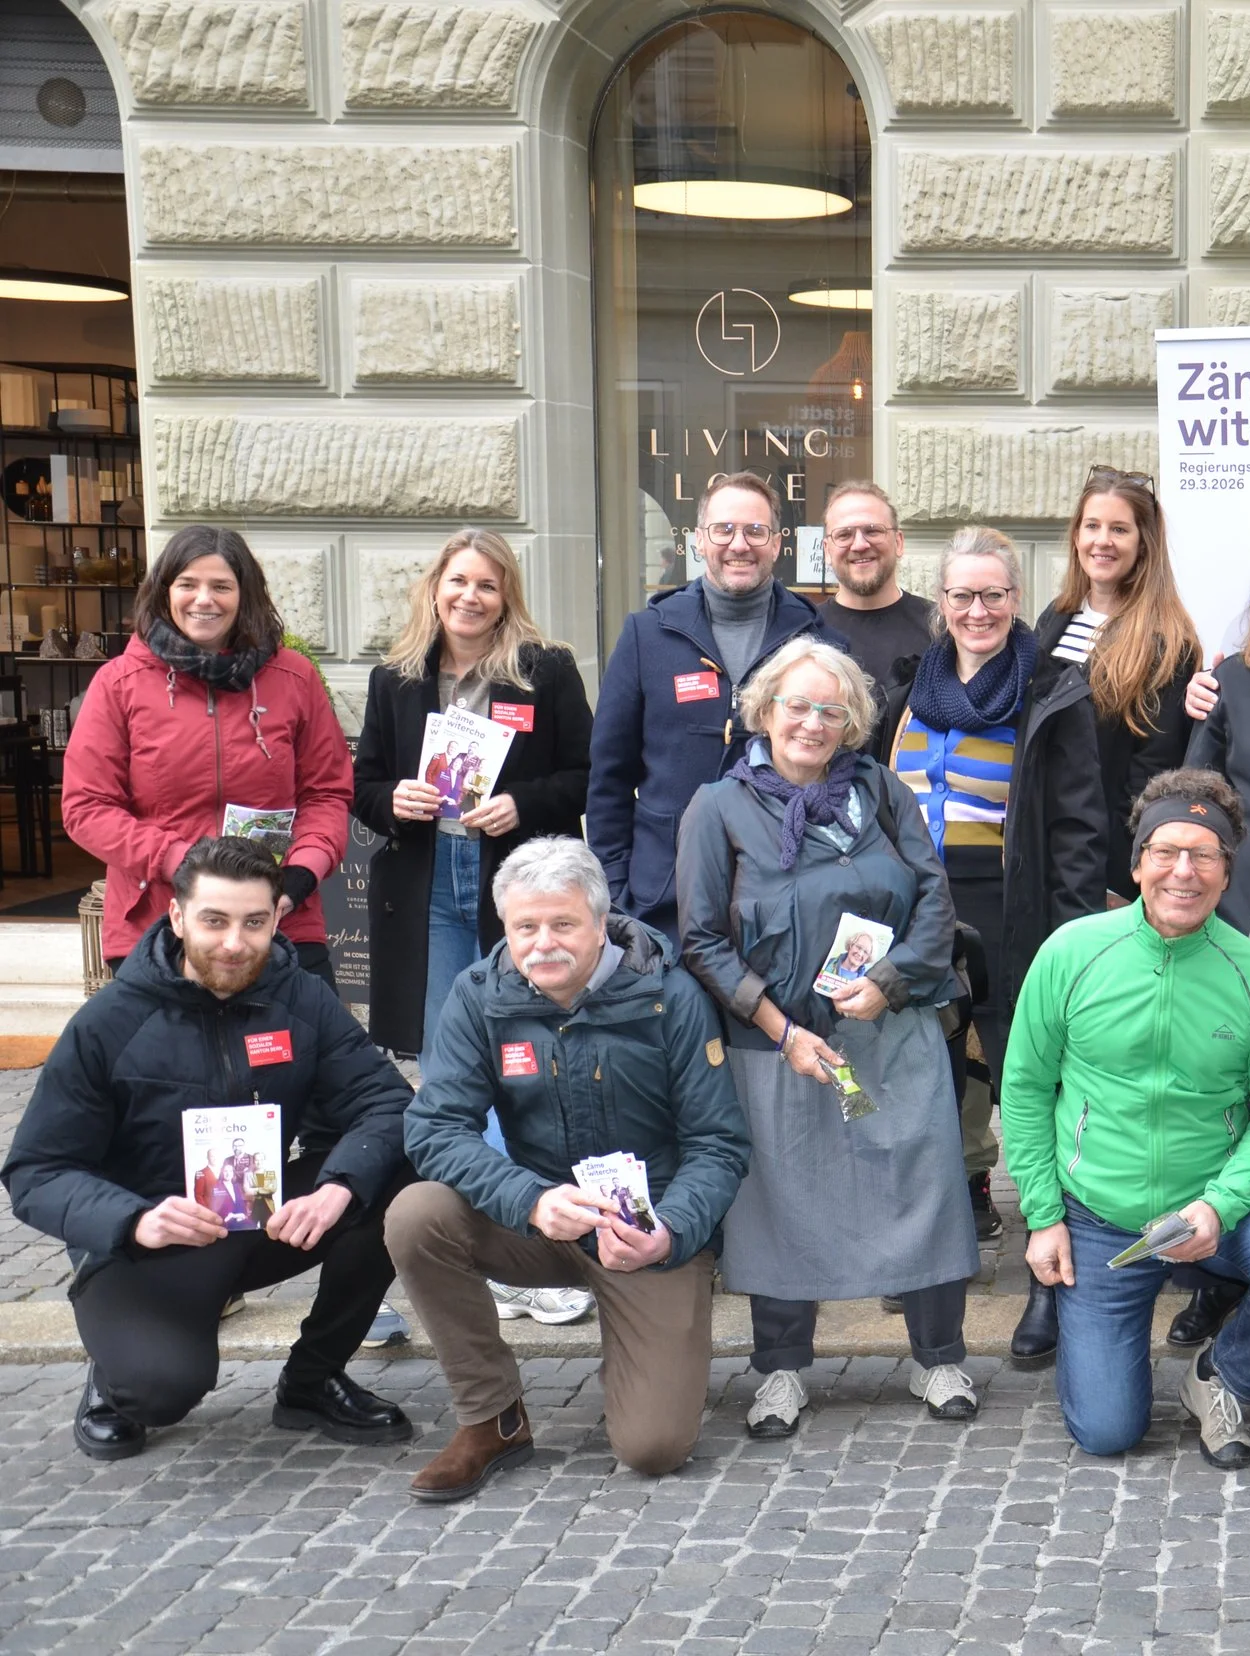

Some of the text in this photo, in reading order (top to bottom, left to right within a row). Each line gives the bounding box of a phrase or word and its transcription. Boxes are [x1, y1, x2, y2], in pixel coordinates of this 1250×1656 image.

[651, 429, 829, 457] LIVING
[1180, 479, 1245, 490] 29.3.2026
[449, 710, 474, 726] Zäme
[447, 720, 486, 739] witercho
[341, 863, 369, 874] LIVI
